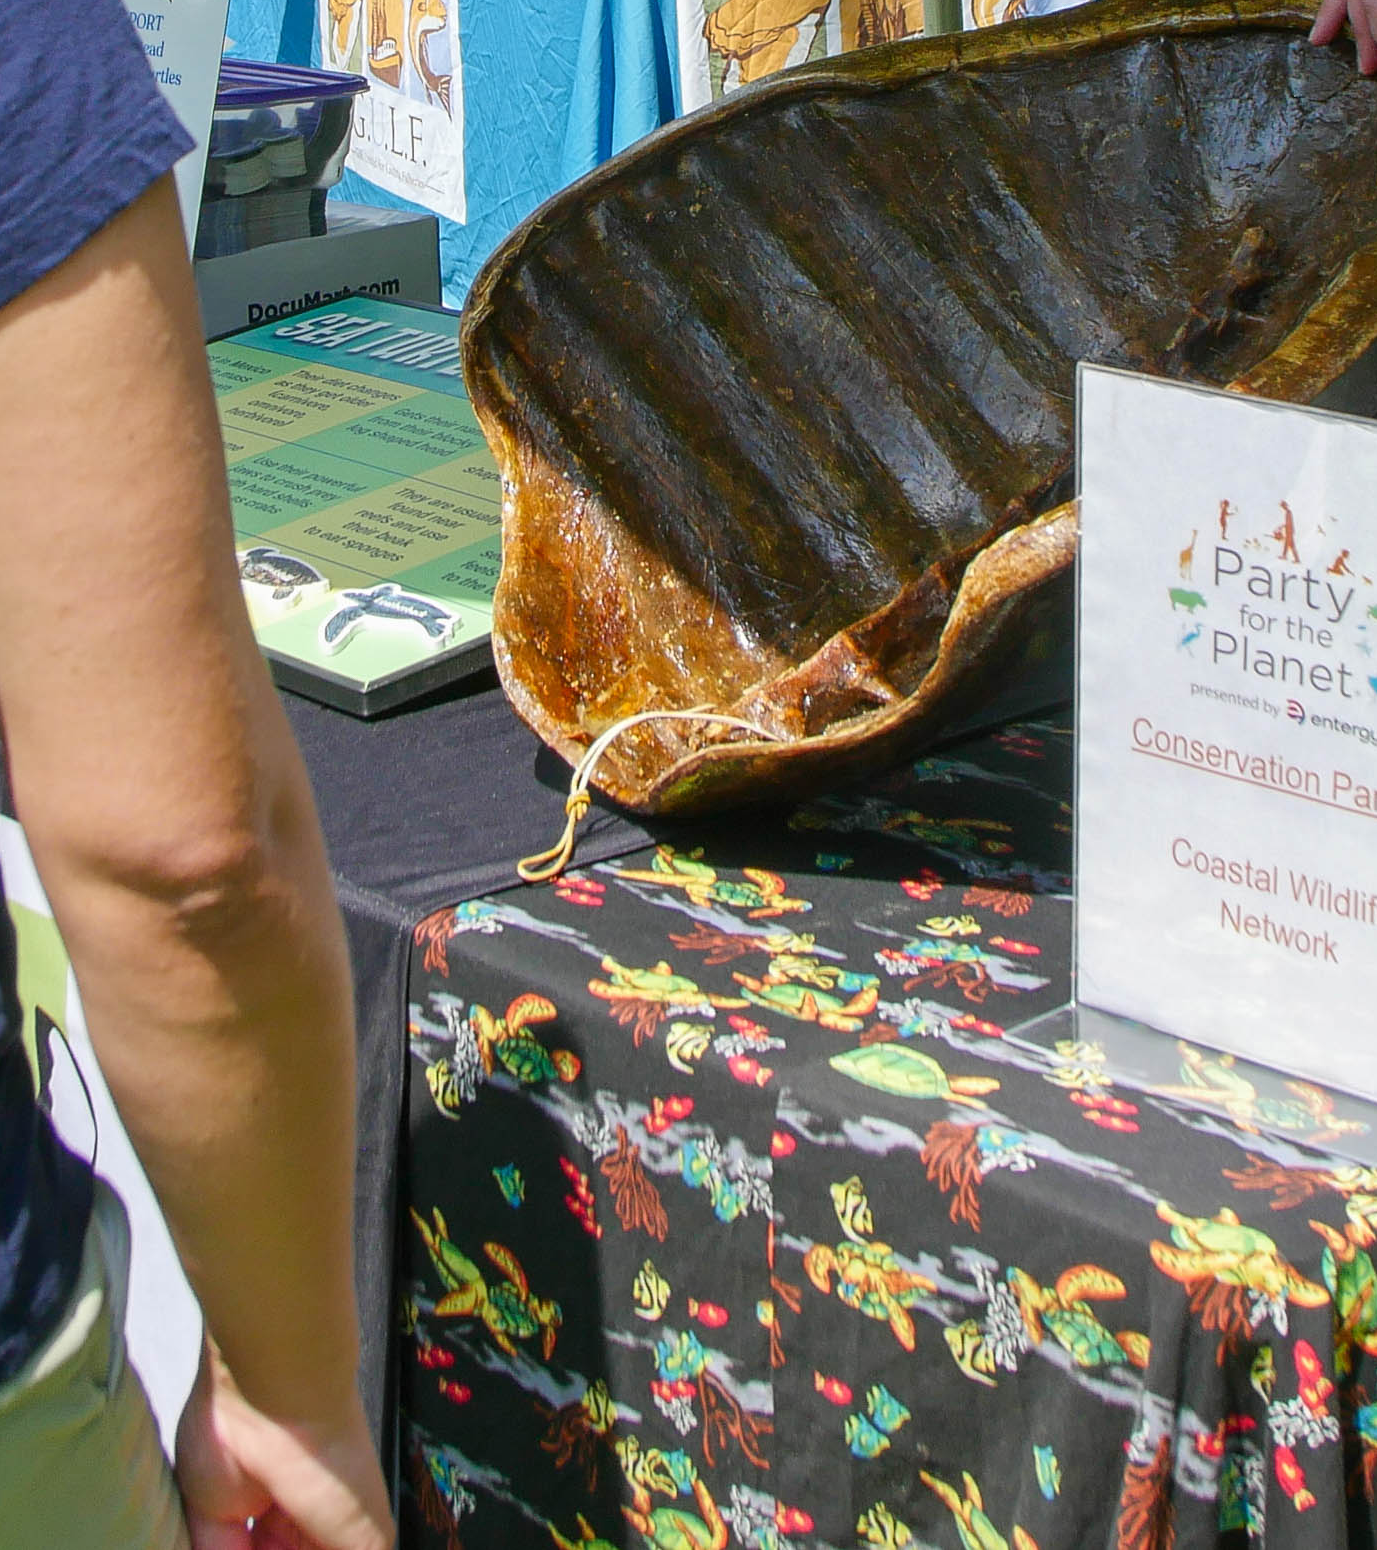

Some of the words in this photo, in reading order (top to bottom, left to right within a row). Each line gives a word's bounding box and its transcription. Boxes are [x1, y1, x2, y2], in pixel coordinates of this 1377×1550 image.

[129, 11, 164, 31] PORT
[143, 41, 164, 57] ead
[155, 67, 182, 85] rtles
[248, 278, 400, 324] DocuMartcom
[275, 312, 394, 348] SEA
[346, 327, 463, 379] TURTL
[274, 379, 293, 387] as
[291, 383, 319, 395] they
[314, 389, 342, 400] get
[339, 395, 375, 407] older
[293, 370, 324, 381] Their
[323, 375, 351, 388] diet
[347, 382, 402, 401] changes
[368, 416, 402, 428] from
[399, 424, 434, 436] their
[431, 432, 479, 448] blocky
[394, 408, 426, 420] Gets
[424, 416, 459, 427] their
[346, 424, 373, 436] log
[368, 431, 419, 448] shaped
[416, 442, 457, 456] head
[253, 457, 279, 467] Use
[277, 464, 311, 476] their
[302, 473, 368, 492] powerful
[274, 478, 312, 492] crush
[306, 489, 342, 501] prey
[244, 484, 279, 497] hard
[273, 493, 313, 508] shells
[244, 500, 282, 514] crabs
[395, 488, 433, 502] They
[428, 498, 455, 509] are
[355, 509, 394, 524] reefs
[390, 520, 421, 533] and
[419, 530, 450, 541] use
[387, 502, 431, 519] found
[428, 515, 466, 529] near
[303, 526, 322, 535] to
[320, 532, 348, 543] eat
[342, 540, 405, 562] sponges
[343, 521, 382, 536] their
[376, 531, 415, 548] beak
[441, 572, 461, 582] to
[458, 578, 487, 590] the
[1213, 545, 1355, 623] Party
[1239, 603, 1278, 633] for
[1285, 616, 1334, 649] the
[1212, 630, 1354, 699] Planet
[1190, 682, 1260, 711] presented
[1261, 696, 1280, 717] by
[1132, 717, 1322, 797] Conservation
[1171, 837, 1279, 895] Coastal
[1221, 898, 1340, 965] Network
